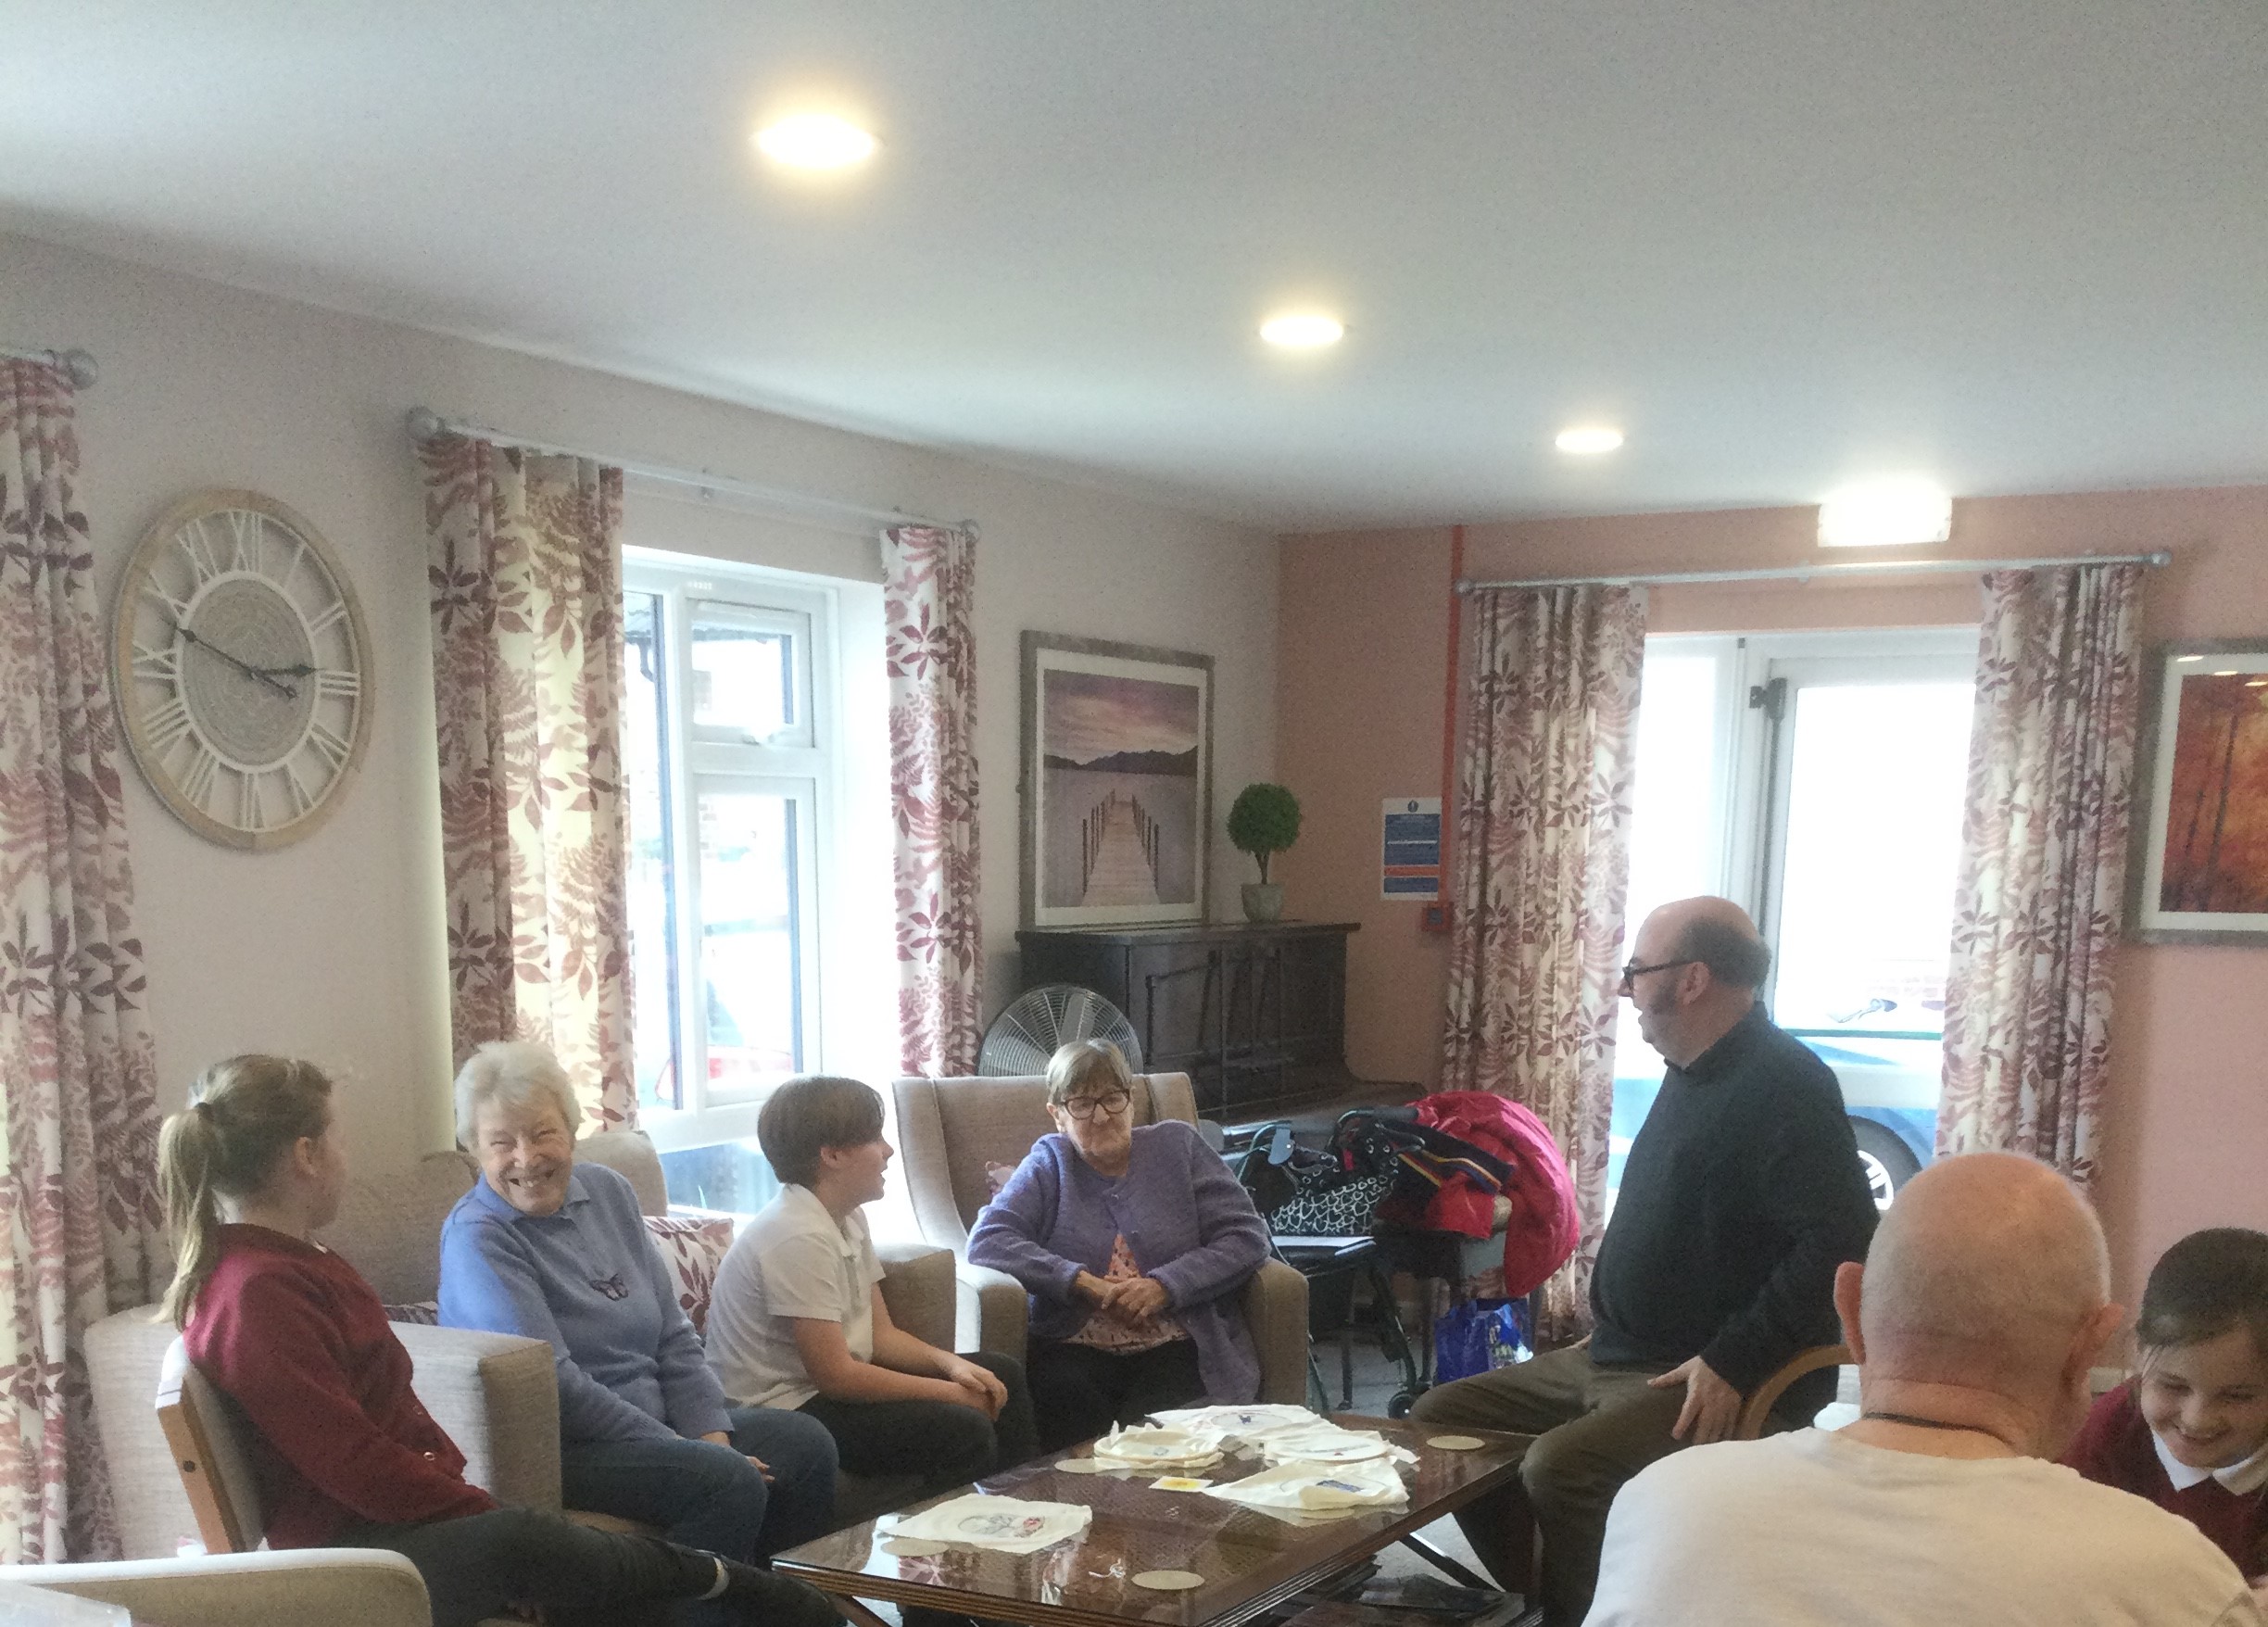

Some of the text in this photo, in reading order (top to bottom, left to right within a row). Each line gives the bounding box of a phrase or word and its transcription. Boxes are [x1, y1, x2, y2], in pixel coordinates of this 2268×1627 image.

[174, 519, 220, 586] XI
[229, 511, 262, 572] XII
[284, 540, 307, 591] I
[144, 570, 188, 619] X
[309, 600, 346, 633] II
[319, 670, 359, 696] III
[285, 762, 315, 816] V
